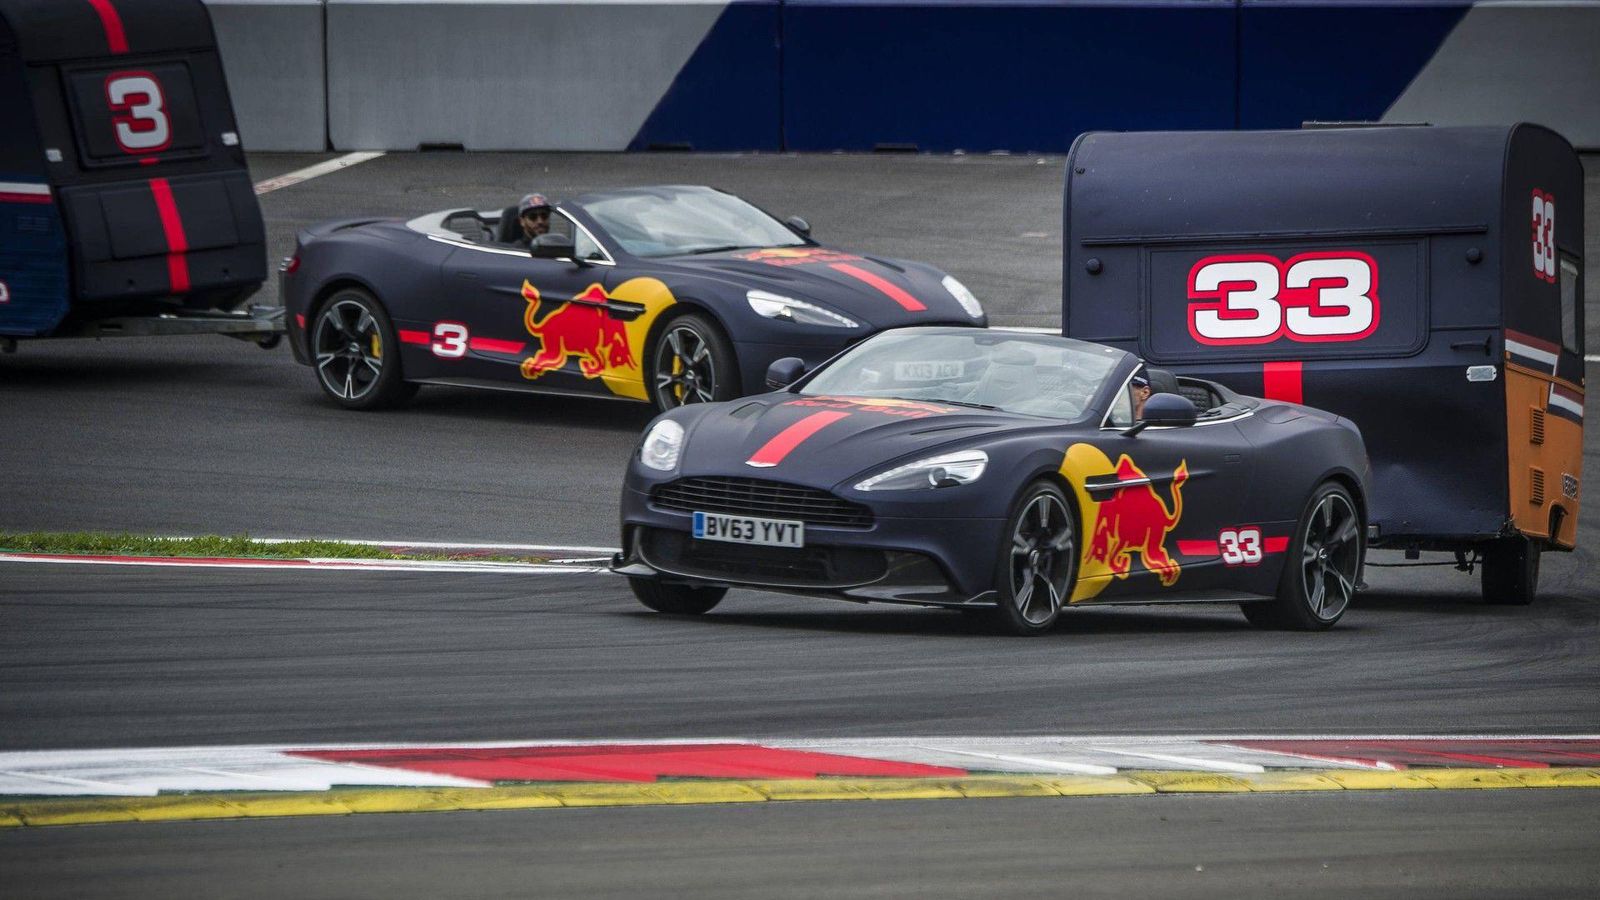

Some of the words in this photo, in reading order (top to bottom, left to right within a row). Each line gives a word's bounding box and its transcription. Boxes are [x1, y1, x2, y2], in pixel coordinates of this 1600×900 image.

[106, 73, 171, 152] 3
[1532, 190, 1555, 281] 33
[1190, 254, 1378, 343] 33
[432, 322, 468, 358] 3
[706, 516, 755, 540] BV63
[761, 521, 800, 544] YVT
[1219, 528, 1262, 565] 33
